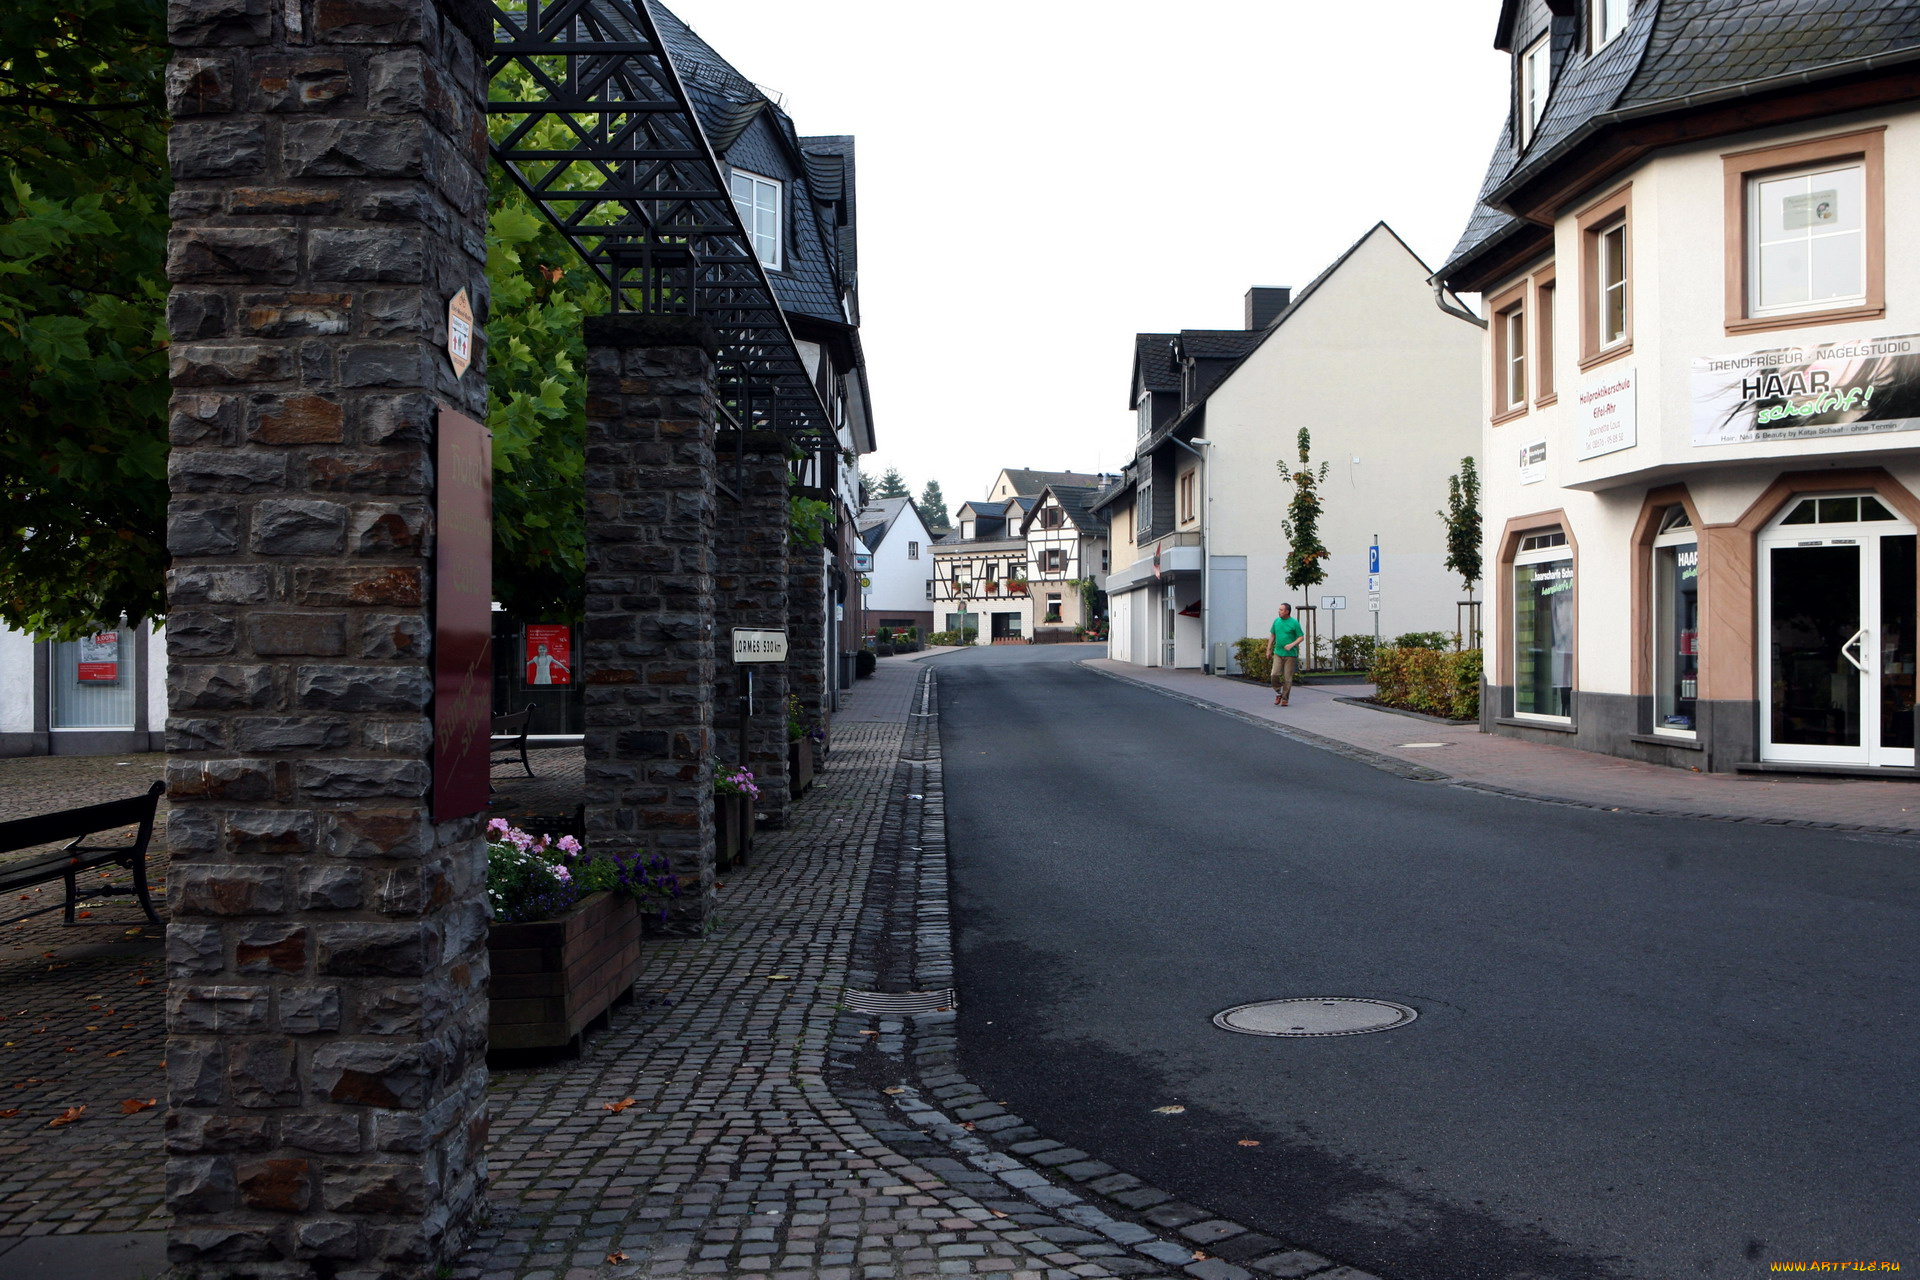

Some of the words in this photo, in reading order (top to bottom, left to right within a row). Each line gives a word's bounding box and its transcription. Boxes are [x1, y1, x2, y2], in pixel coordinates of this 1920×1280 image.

[1708, 353, 1803, 371] TRENDFRISEUR
[1816, 341, 1911, 361] NAGELSTUDIO
[1580, 379, 1630, 404] Heilpraktikerschule
[1742, 370, 1831, 403] HAAR
[1762, 430, 1788, 440] Beauty
[1788, 430, 1796, 438] by
[1871, 422, 1897, 431] Termin
[1371, 549, 1377, 570] P
[736, 640, 760, 653] LORMES
[763, 640, 773, 653] 530
[774, 641, 782, 653] km
